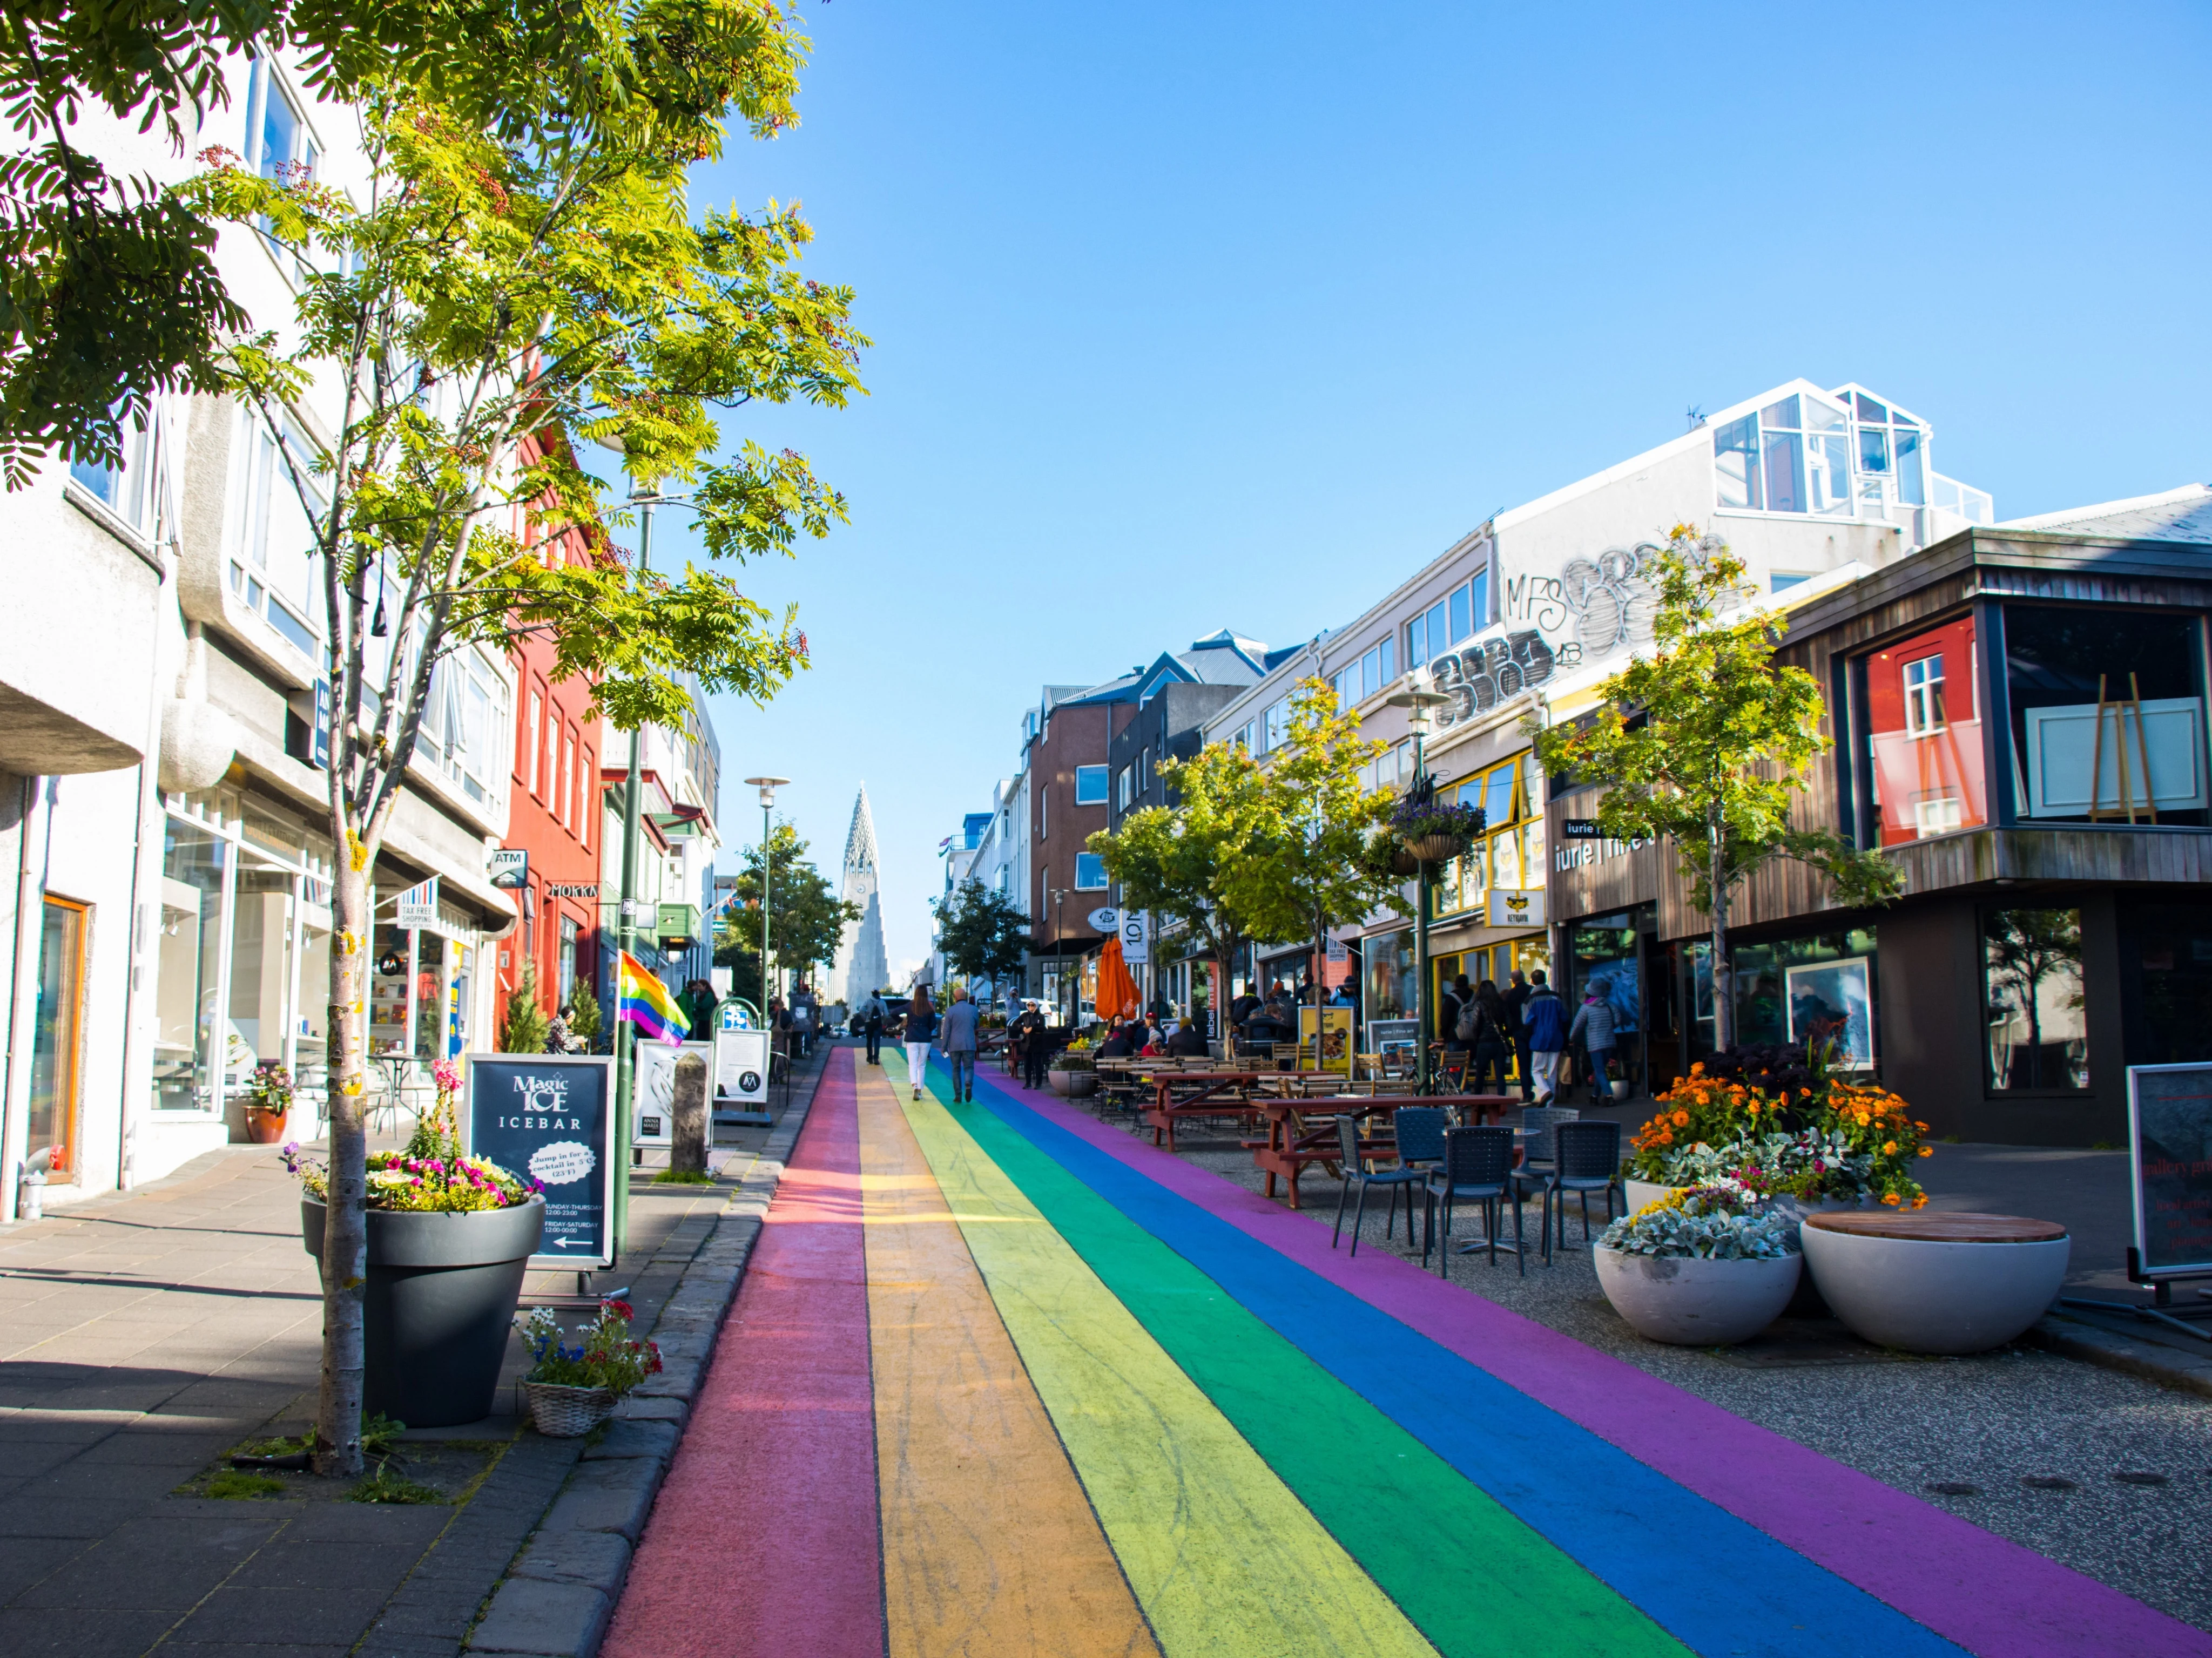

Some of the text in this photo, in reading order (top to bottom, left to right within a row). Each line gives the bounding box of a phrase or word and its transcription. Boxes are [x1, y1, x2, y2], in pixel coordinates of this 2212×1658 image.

[1568, 823, 1594, 833] iurie
[495, 854, 521, 863] ATM
[1555, 838, 1593, 872] iurie
[551, 884, 598, 899] MOKKA
[514, 1075, 569, 1094] Magic
[523, 1089, 570, 1112] ICE
[499, 1116, 581, 1129] ICEBAR
[533, 1161, 565, 1172] cocktail
[2142, 1158, 2187, 1180] gallery
